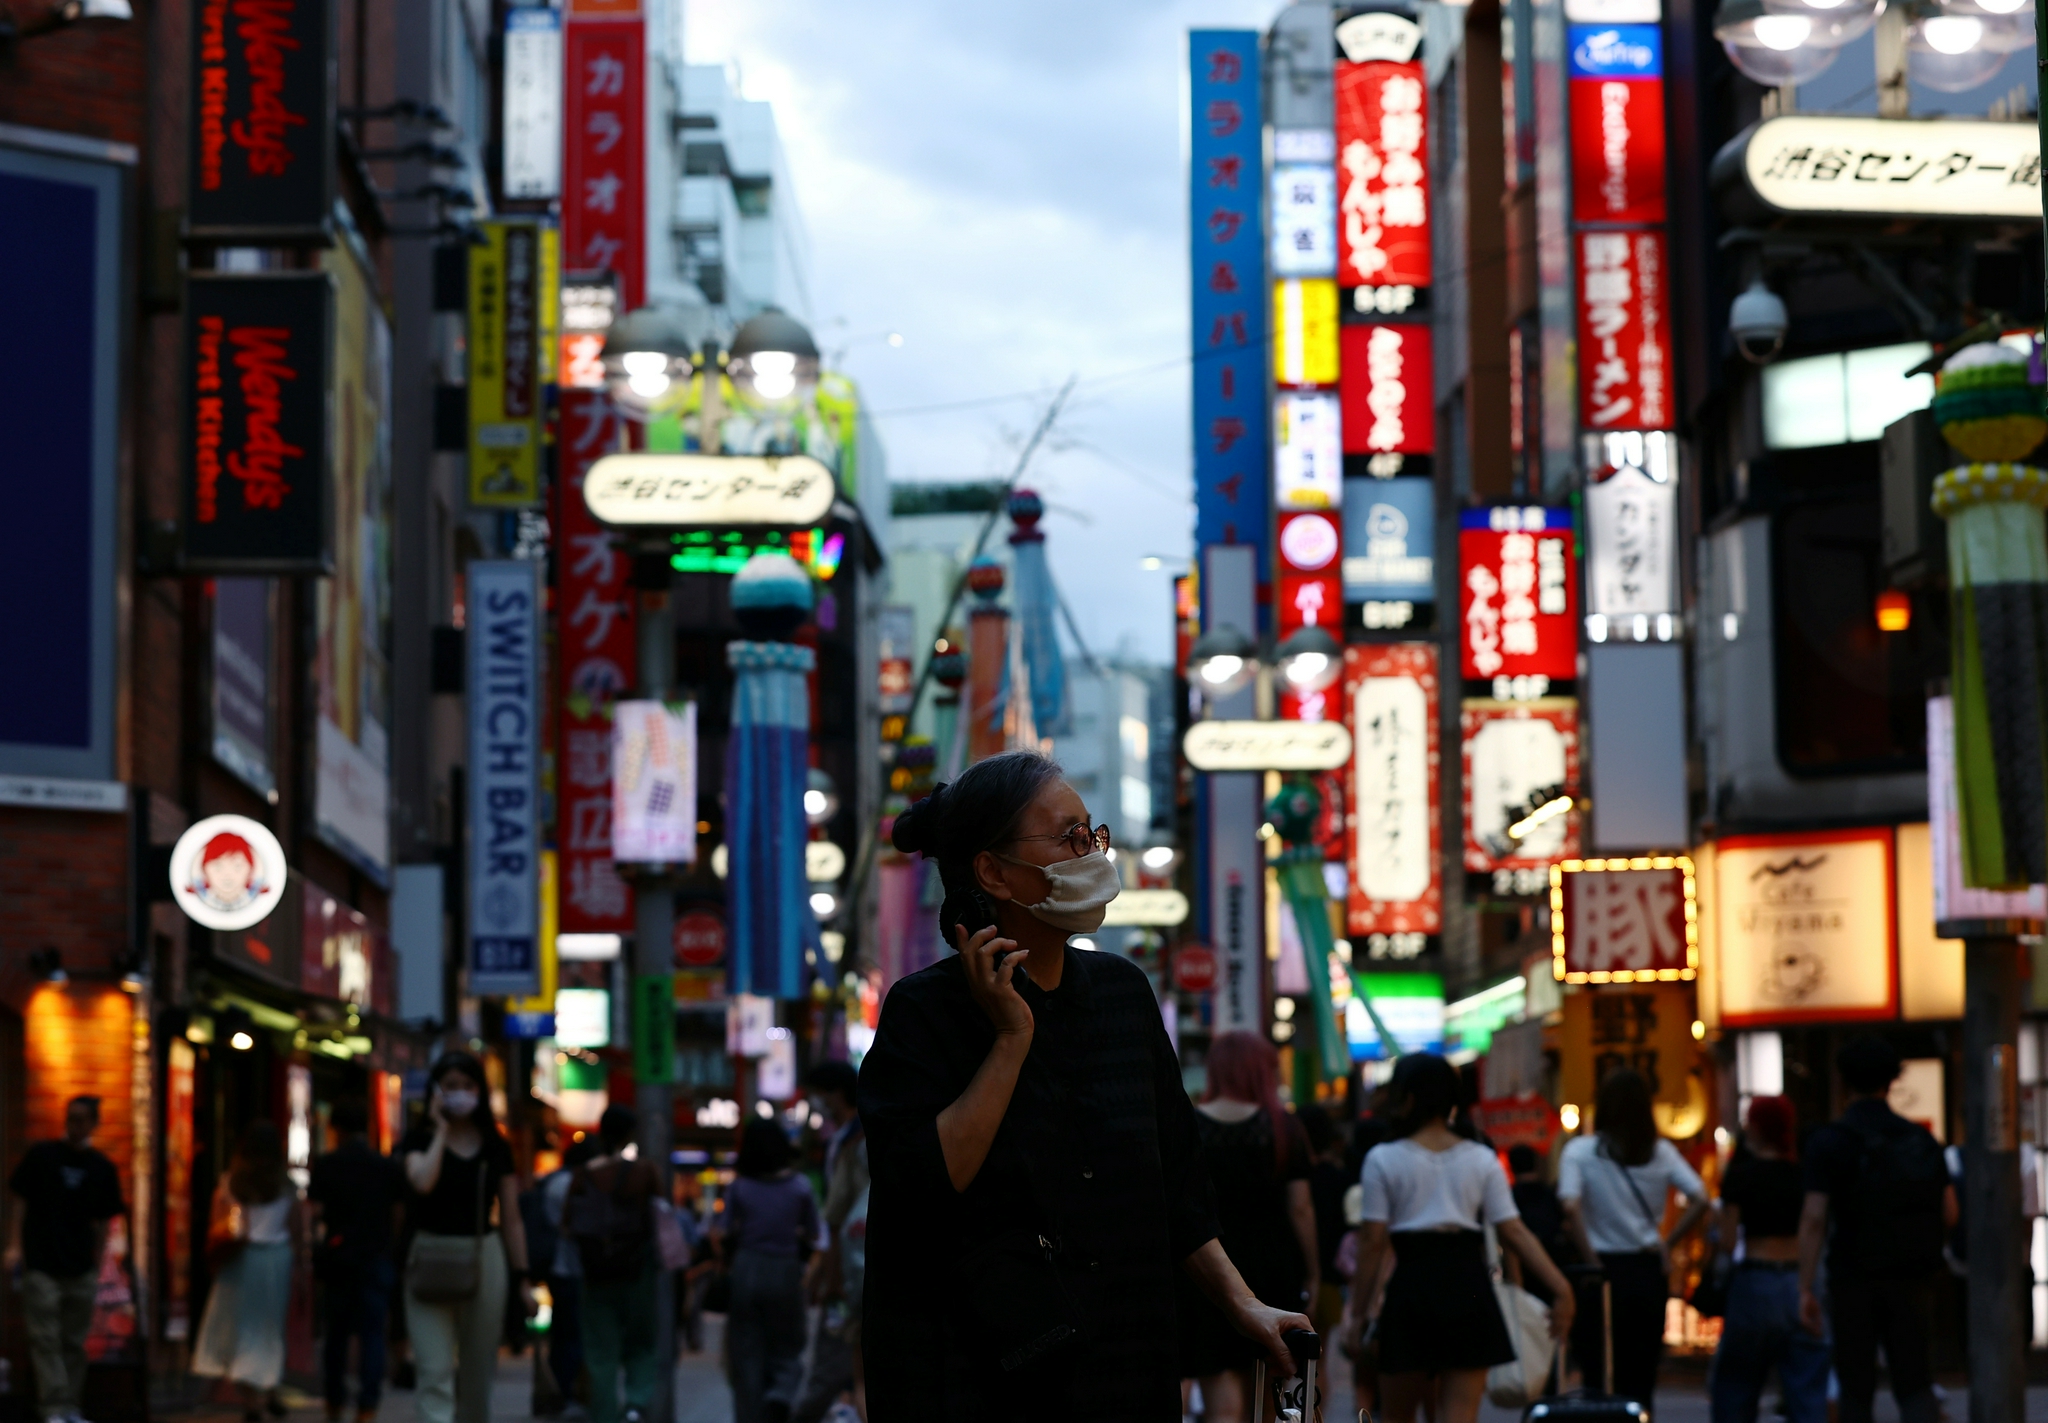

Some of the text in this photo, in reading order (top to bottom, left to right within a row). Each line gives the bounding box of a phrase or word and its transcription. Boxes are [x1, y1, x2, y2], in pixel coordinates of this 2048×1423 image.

[202, 66, 228, 191] Kitchen
[196, 315, 224, 524] First Kitchen
[226, 326, 304, 512] Wendy's
[487, 589, 528, 878] SWITCH BAR
[568, 386, 628, 918] カオケの歌広場
[1570, 870, 1682, 970] 豚
